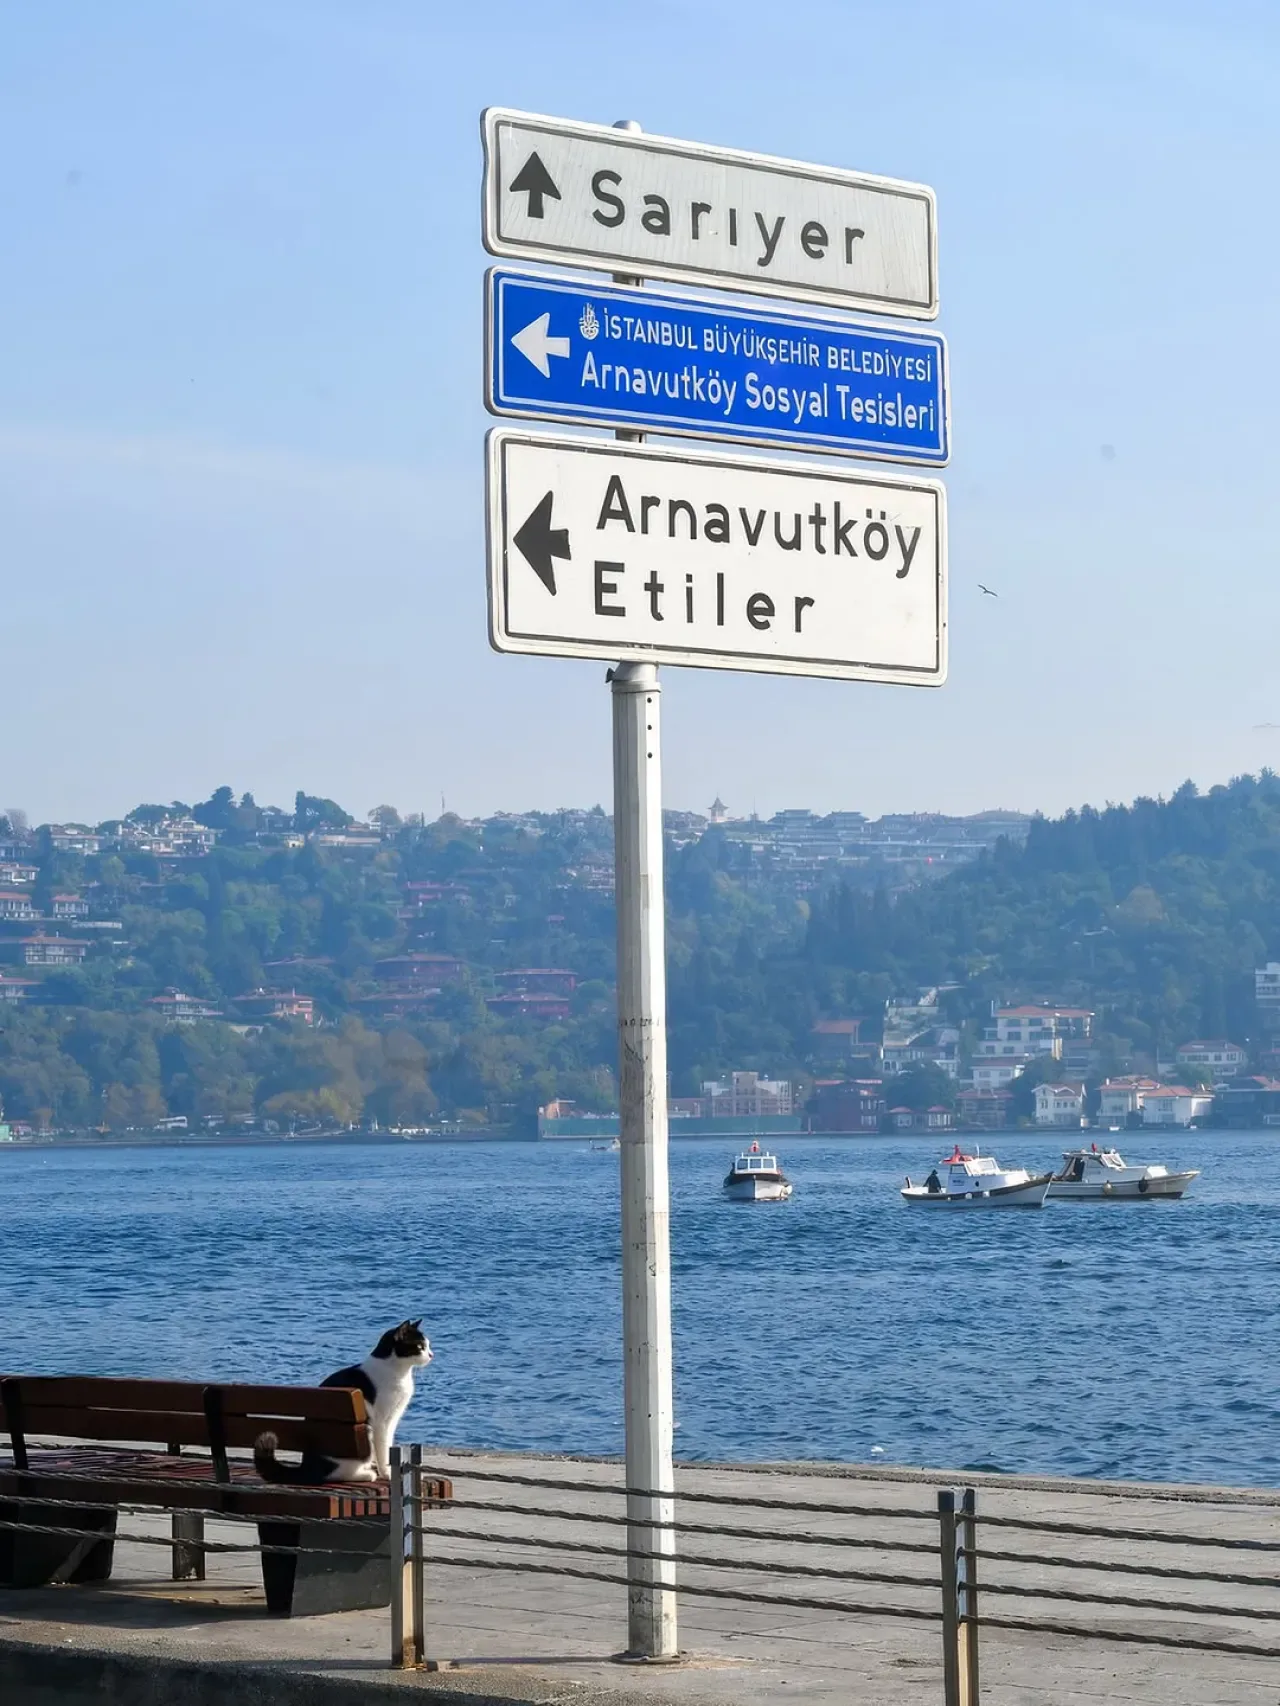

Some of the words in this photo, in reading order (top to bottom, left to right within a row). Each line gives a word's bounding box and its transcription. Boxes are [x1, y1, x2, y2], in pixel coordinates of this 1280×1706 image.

[591, 170, 865, 267] Sarıyer
[603, 307, 698, 350] İSTANBUL
[703, 323, 820, 368] BÜYÜKŞEHİR
[828, 346, 932, 382] BELEDİYESİ
[581, 352, 738, 415] Arnavutköy
[745, 373, 828, 424] Sosyal
[836, 384, 935, 432] Tesisleri
[596, 474, 922, 579] Arnavutköy
[593, 560, 815, 633] Etiler
